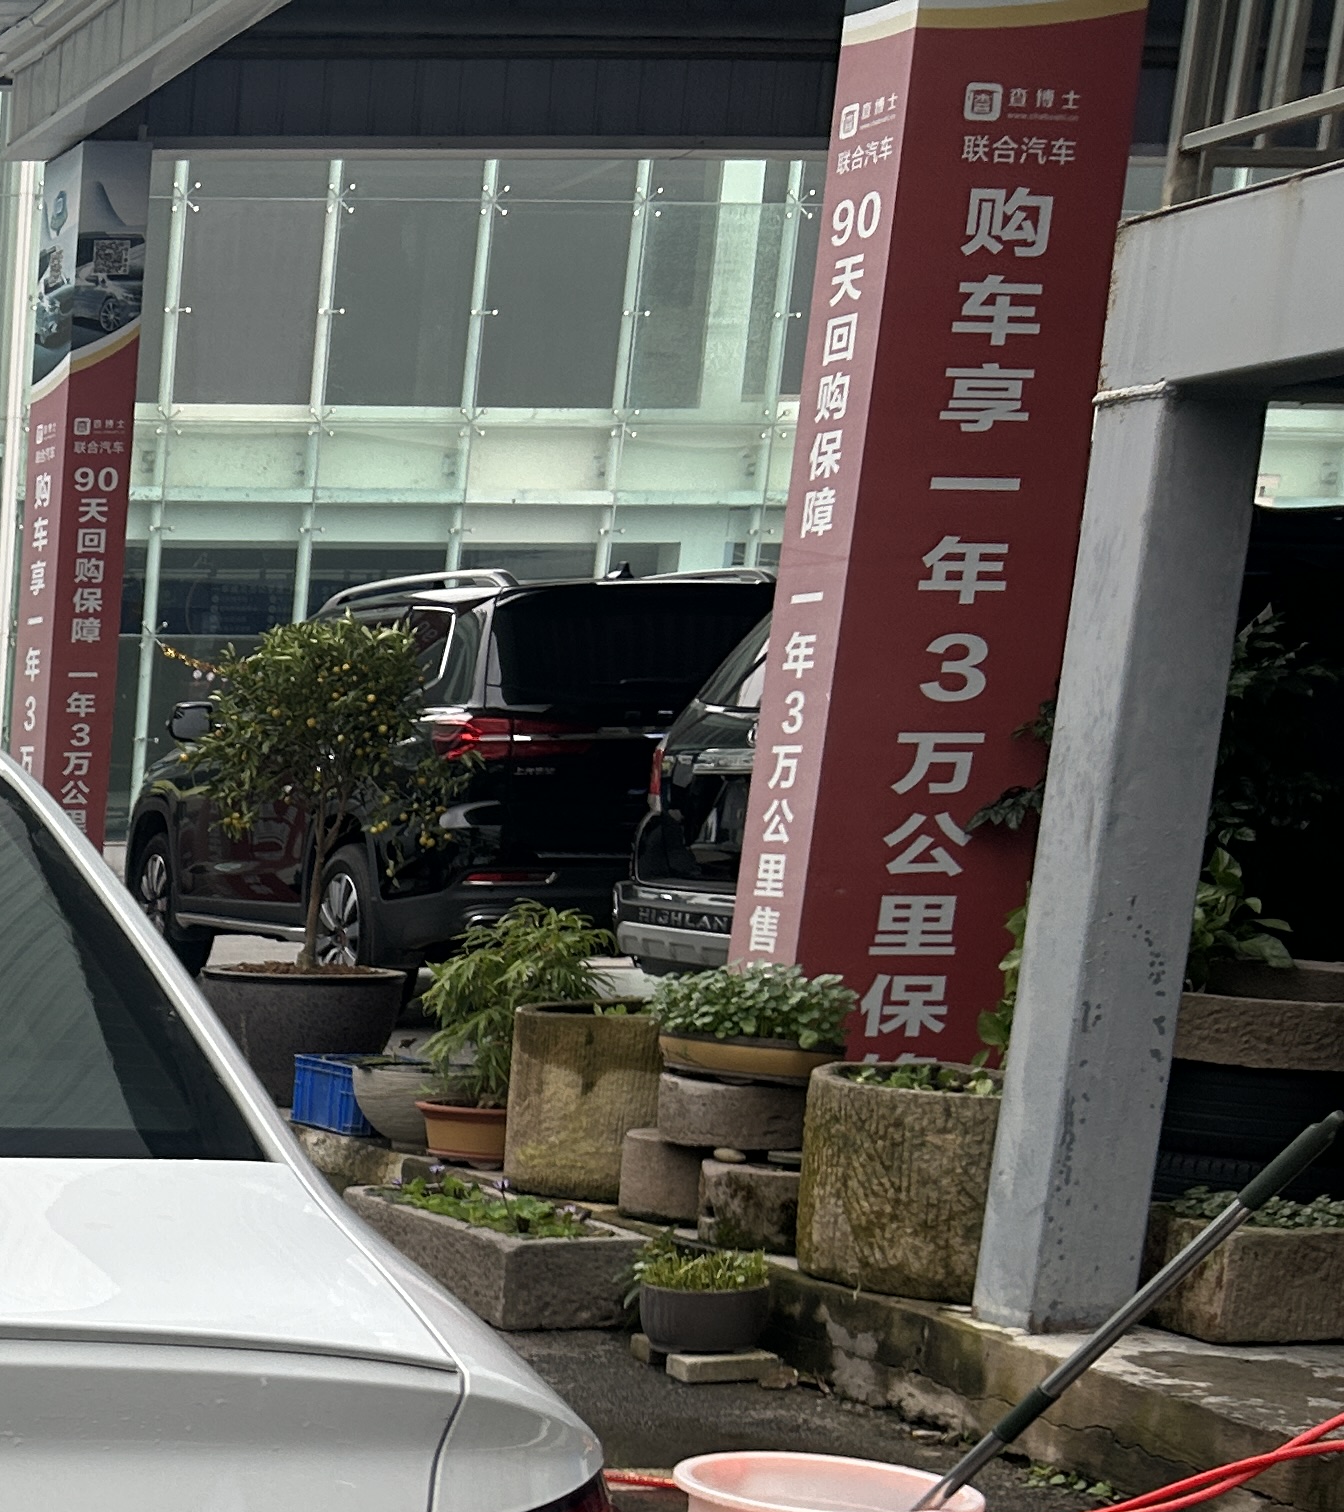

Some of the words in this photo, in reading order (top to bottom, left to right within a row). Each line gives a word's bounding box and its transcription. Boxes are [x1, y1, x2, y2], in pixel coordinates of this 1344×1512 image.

[836, 136, 894, 175] 联合汽车
[962, 135, 1077, 166] 联合汽车
[800, 190, 882, 538] 90天回购保障
[71, 467, 119, 643] 90天回购保障
[859, 187, 1053, 1063] 购车享一年3万公里保
[747, 591, 824, 978] 一年3万公里售
